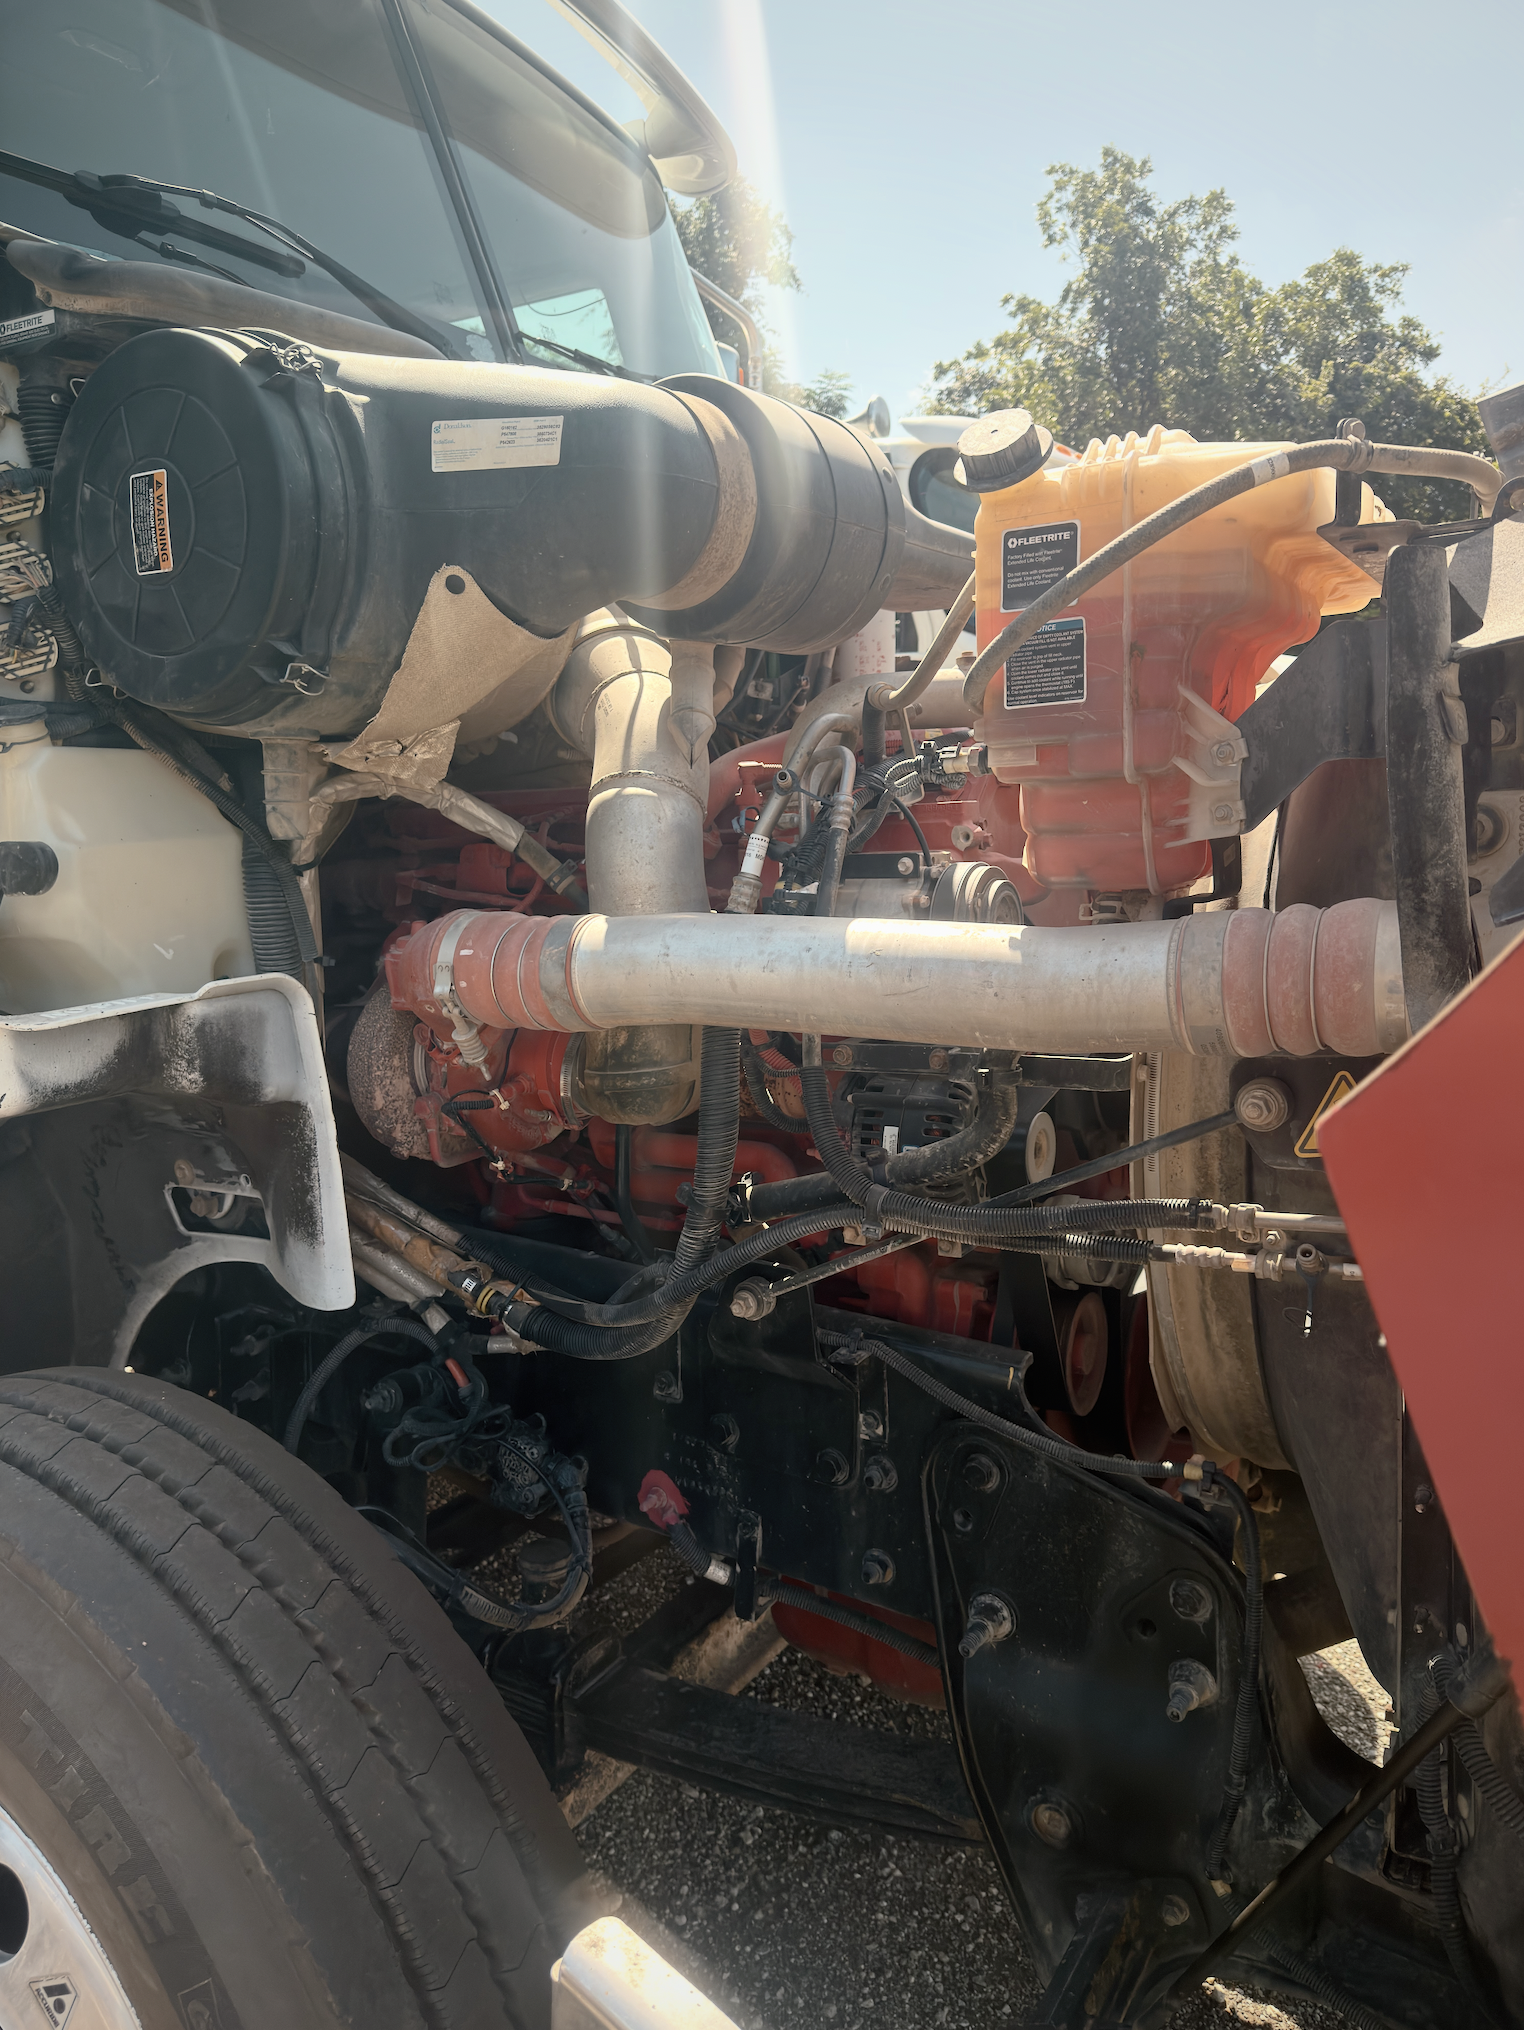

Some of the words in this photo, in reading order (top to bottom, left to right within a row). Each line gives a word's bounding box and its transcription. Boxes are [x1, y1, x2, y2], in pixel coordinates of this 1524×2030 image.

[7, 315, 43, 332] FLEETRITE
[156, 494, 169, 562] WARNING
[1018, 531, 1070, 546] FLEETRITE
[18, 1708, 176, 1945] TIRE
[35, 1989, 60, 2028] ACCURIDE
